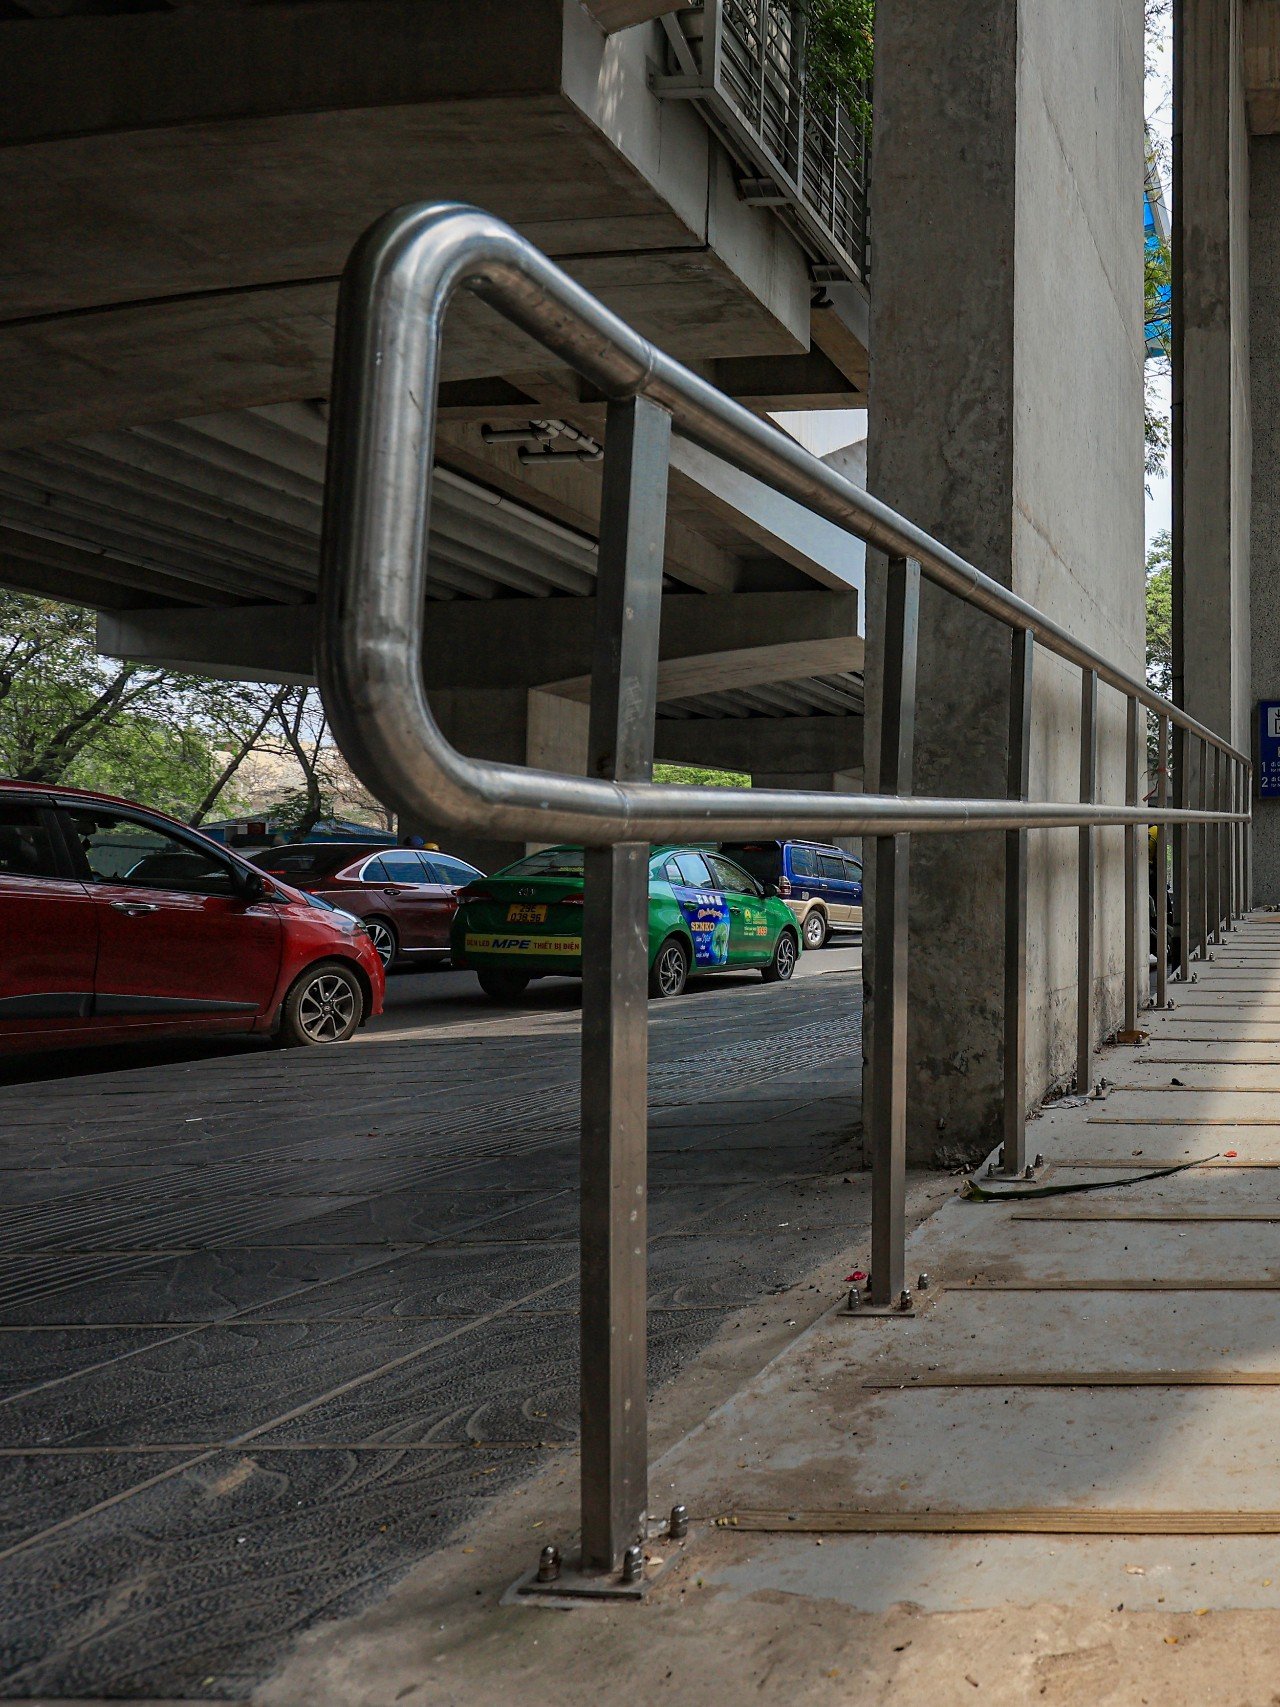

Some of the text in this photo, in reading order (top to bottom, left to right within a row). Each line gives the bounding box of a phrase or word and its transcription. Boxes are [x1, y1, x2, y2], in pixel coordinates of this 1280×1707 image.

[1261, 762, 1266, 773] 1
[1261, 777, 1269, 788] 2
[691, 922, 715, 931] SENKO
[492, 939, 531, 949] MPE
